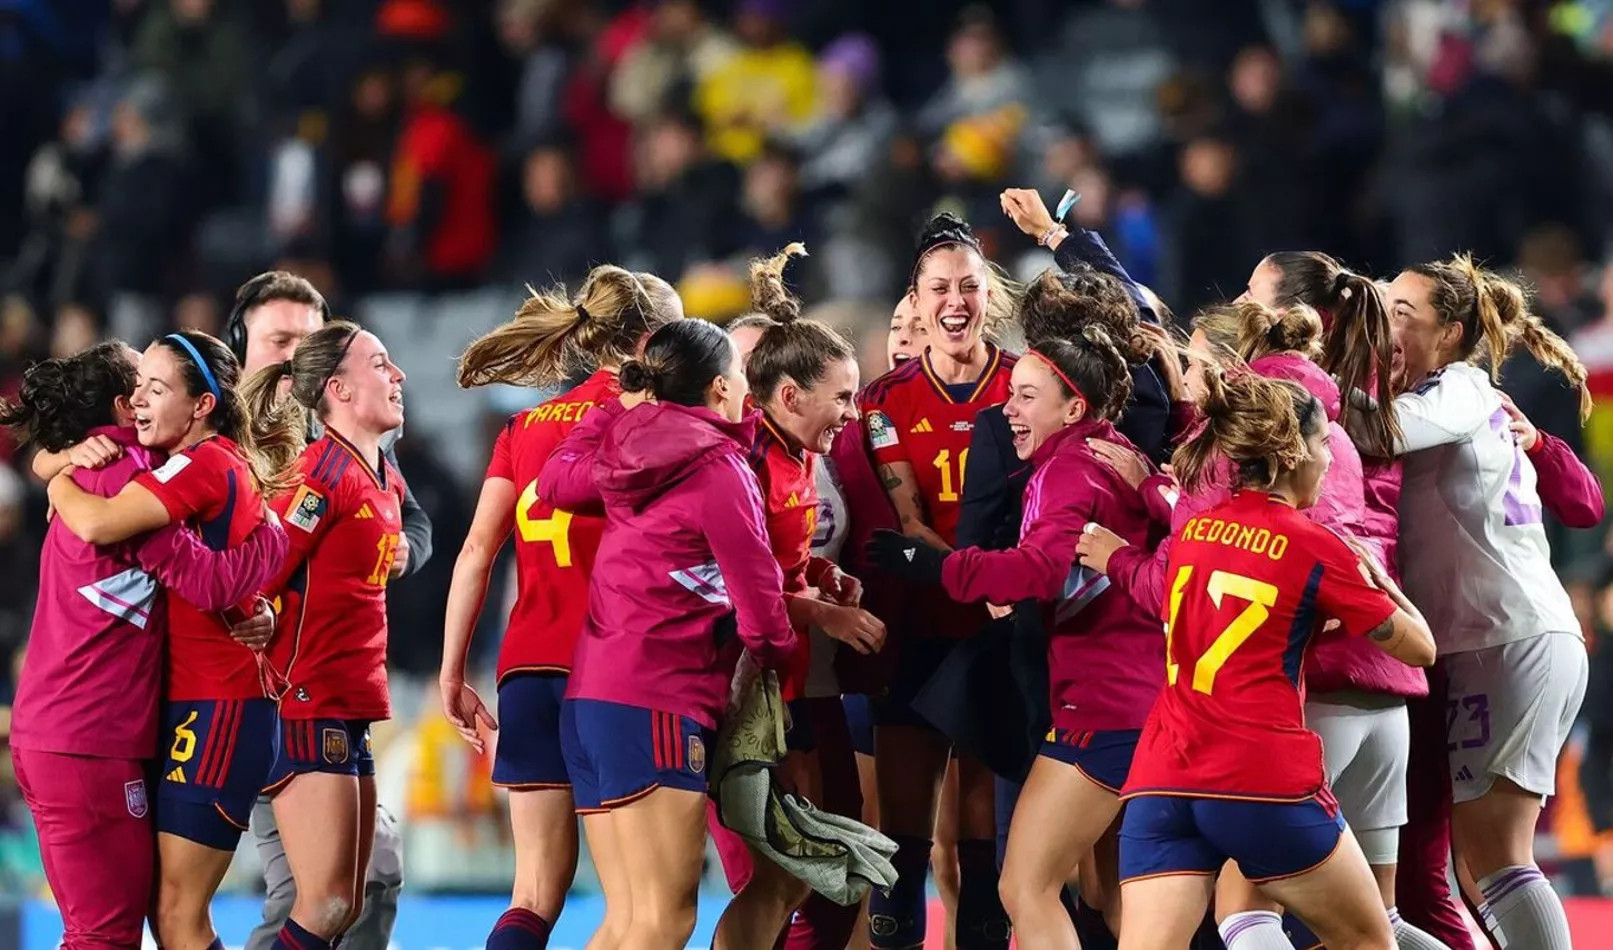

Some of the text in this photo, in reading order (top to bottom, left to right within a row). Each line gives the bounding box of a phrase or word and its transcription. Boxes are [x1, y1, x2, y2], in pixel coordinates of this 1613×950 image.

[933, 447, 969, 502] 1
[516, 477, 574, 568] 4
[1181, 517, 1288, 560] REDONDO
[1167, 565, 1279, 695] 17
[171, 710, 199, 762] 6
